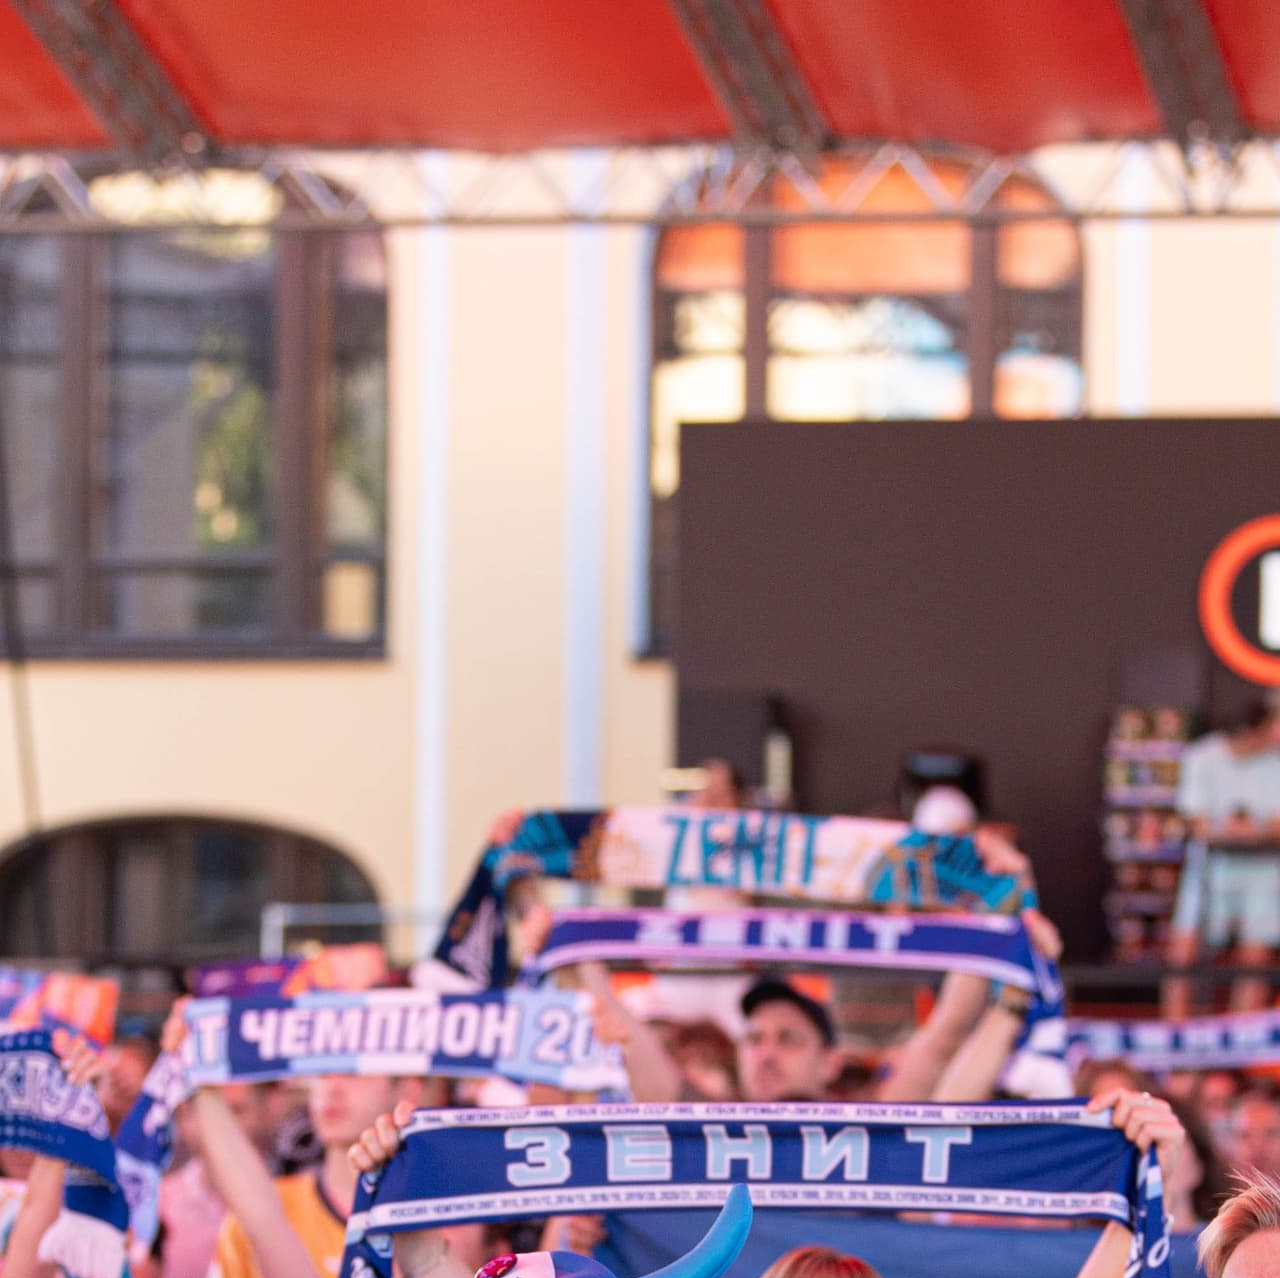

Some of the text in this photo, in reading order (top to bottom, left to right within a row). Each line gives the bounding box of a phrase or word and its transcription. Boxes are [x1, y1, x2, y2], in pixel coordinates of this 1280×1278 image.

[661, 813, 830, 888] ZENIT
[636, 913, 918, 952] ZENIT
[240, 1001, 520, 1061] ЧЕМПИОН
[503, 1124, 973, 1187] ЗЕНИТ
